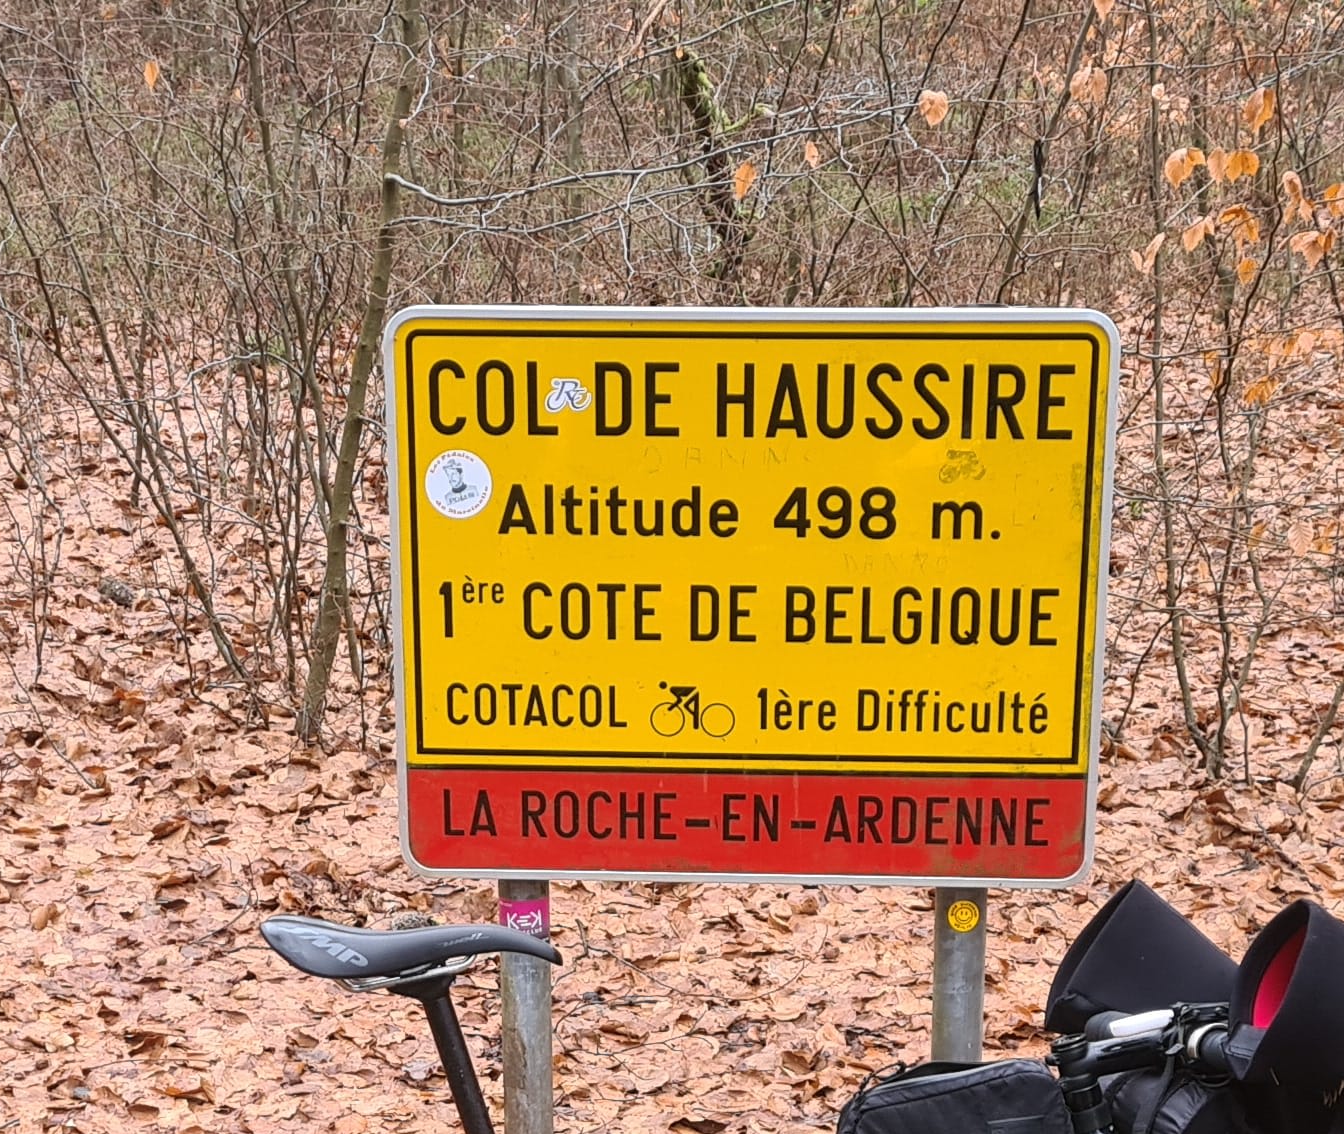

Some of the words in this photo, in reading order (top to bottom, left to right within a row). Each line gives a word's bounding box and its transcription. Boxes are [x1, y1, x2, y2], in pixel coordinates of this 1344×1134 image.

[429, 360, 558, 435] COL
[595, 363, 679, 436] DE
[717, 364, 1075, 439] HAUSSIRE
[499, 485, 738, 537] Altitude
[774, 487, 896, 539] 498
[932, 502, 1000, 539] m.
[439, 577, 504, 638] 1ère
[524, 583, 661, 640] COTE
[691, 586, 756, 641] DE
[786, 587, 1059, 645] BELGIQUE
[447, 684, 626, 727] COTACOL
[758, 689, 835, 730] 1ère
[858, 690, 1047, 733] Difficulté
[444, 790, 496, 836] LA
[522, 791, 1049, 846] ROCHE-EN-ARDENNE
